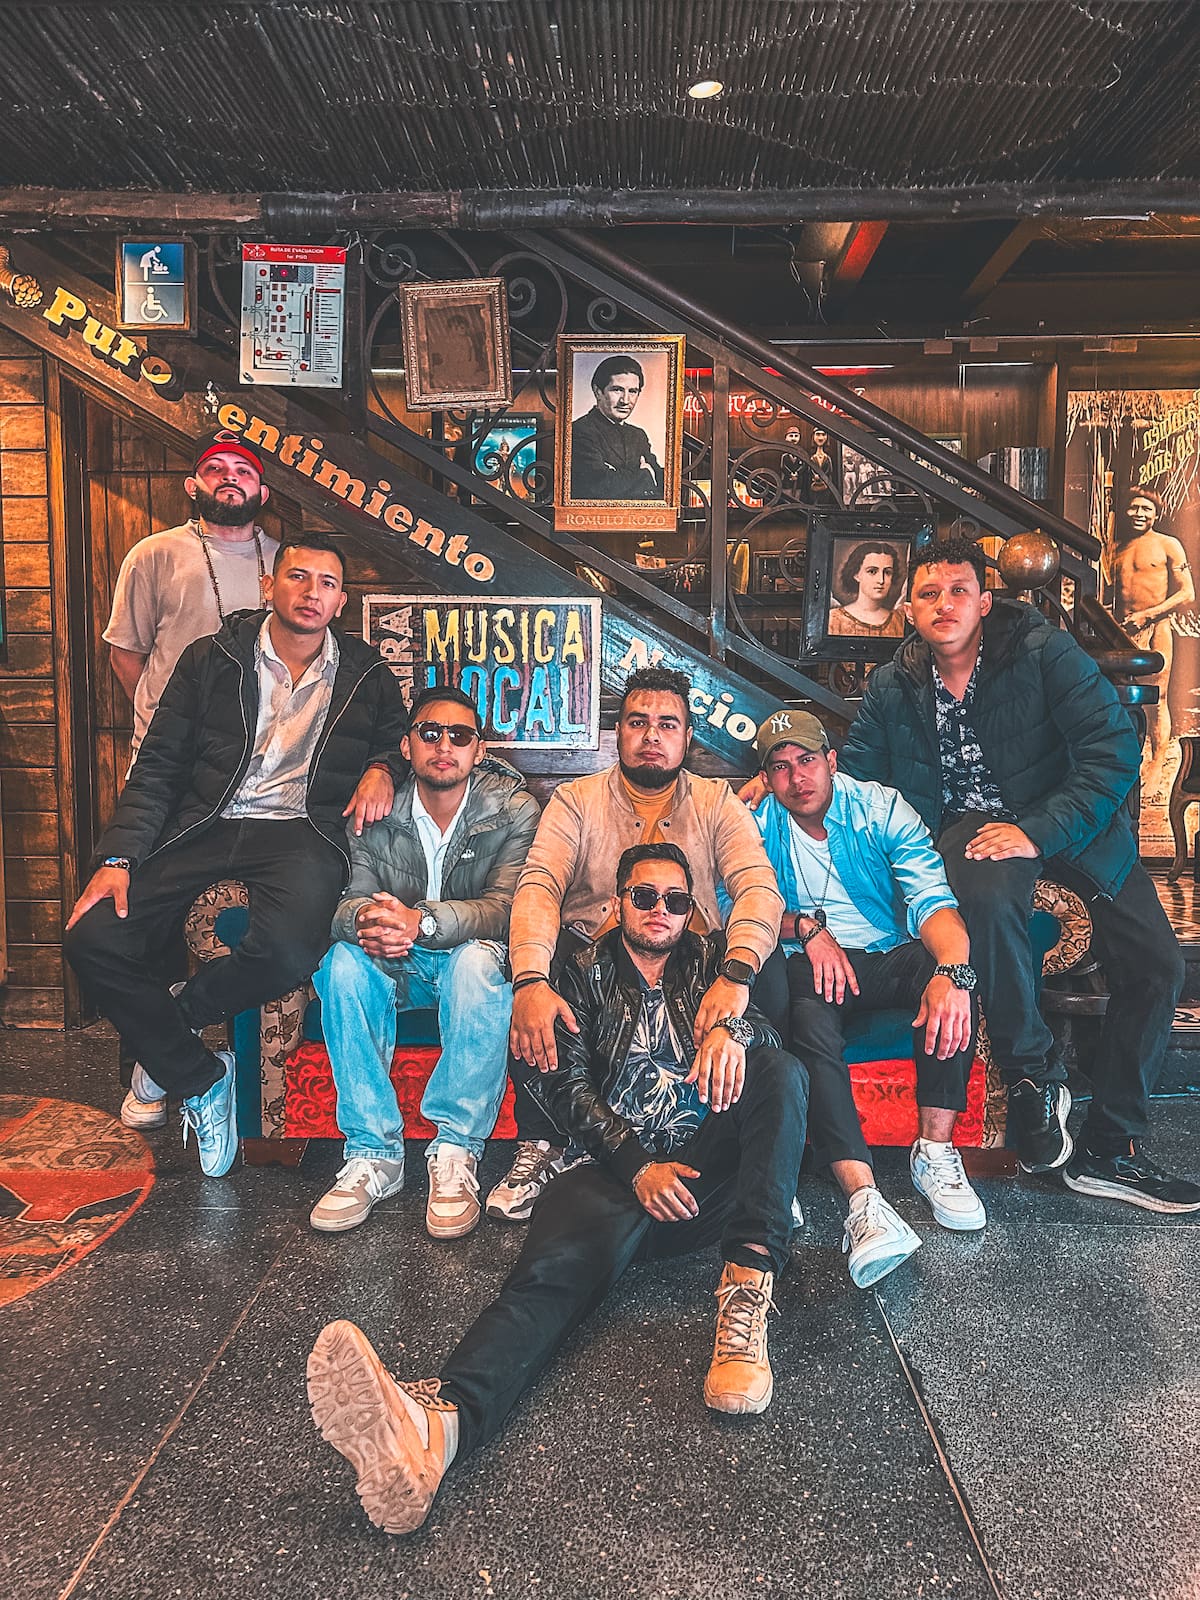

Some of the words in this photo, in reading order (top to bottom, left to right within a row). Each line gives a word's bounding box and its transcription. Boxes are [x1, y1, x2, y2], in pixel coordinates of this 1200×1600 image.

[42, 286, 174, 386] Puro
[566, 513, 624, 526] ROMULO
[628, 513, 666, 526] ROZO
[423, 608, 586, 664] MUSICA
[426, 664, 587, 735] OCAL
[770, 713, 793, 735] NY
